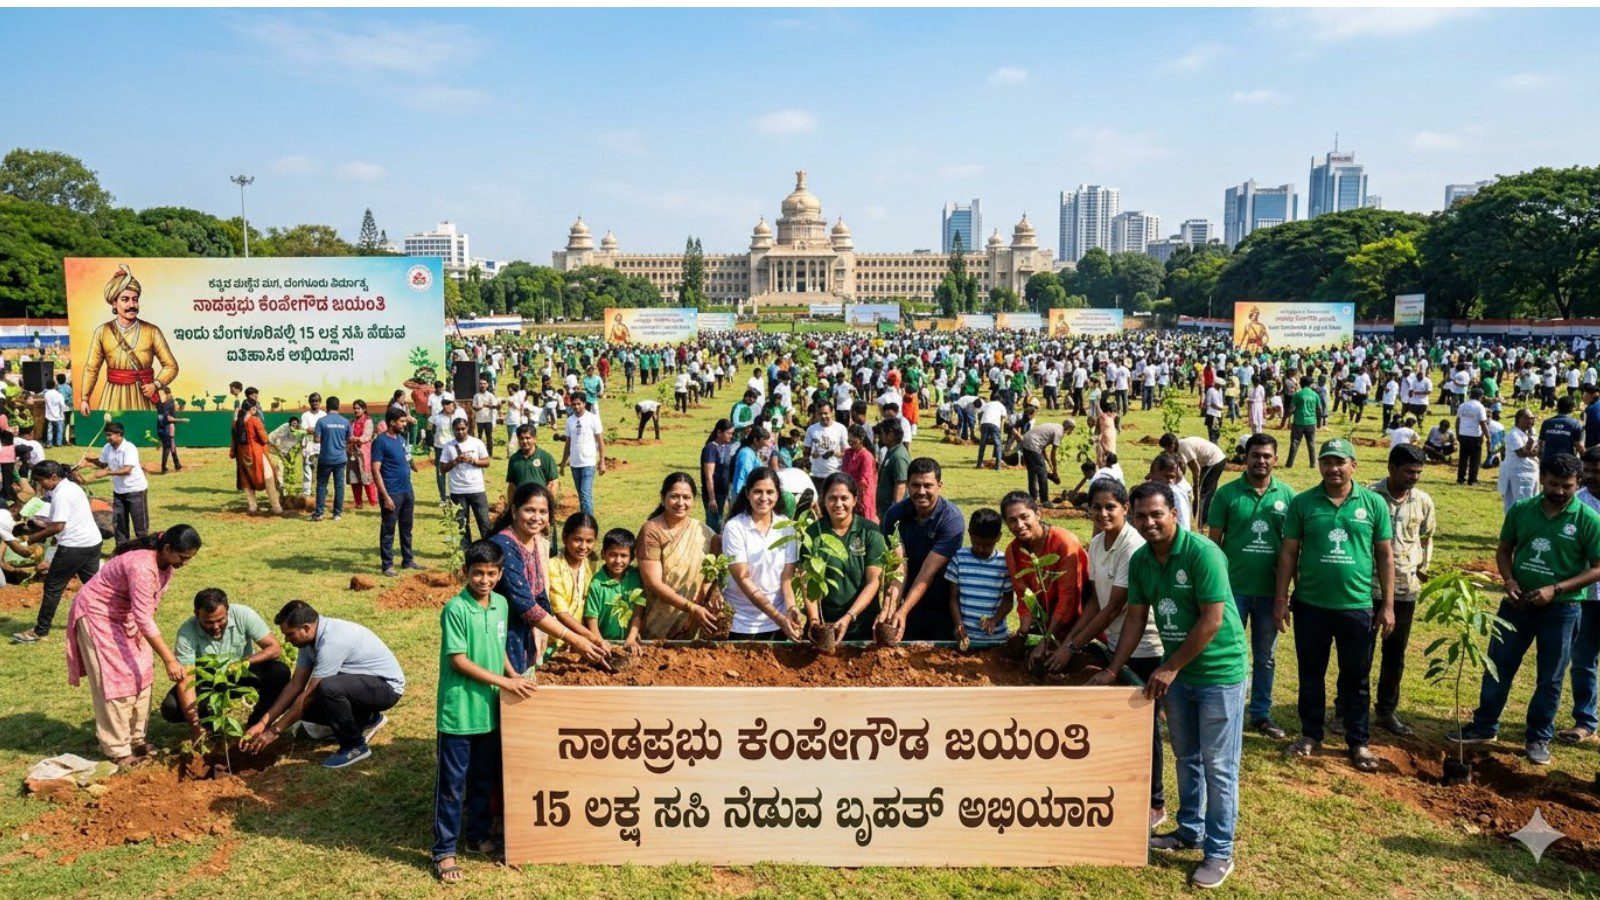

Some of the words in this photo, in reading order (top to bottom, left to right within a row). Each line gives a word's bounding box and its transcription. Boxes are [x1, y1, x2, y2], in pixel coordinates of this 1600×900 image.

[173, 325, 210, 341] ಇಂದು
[299, 326, 315, 340] 15
[558, 718, 723, 774] ನಾಡಪ್ರಭು
[738, 717, 930, 761] ಕೆಂಪೇಗೌಡ
[945, 717, 1091, 760] ಜಯಂತಿ
[532, 790, 572, 828] 15
[584, 786, 641, 848] ಲಕ್ಷ
[654, 786, 710, 828] ಸಸಿ
[724, 785, 823, 829] ನೆಡುವ
[836, 786, 944, 847] ಬೃಹತ್
[958, 785, 1115, 835] ಅಭಿಯಾನ
